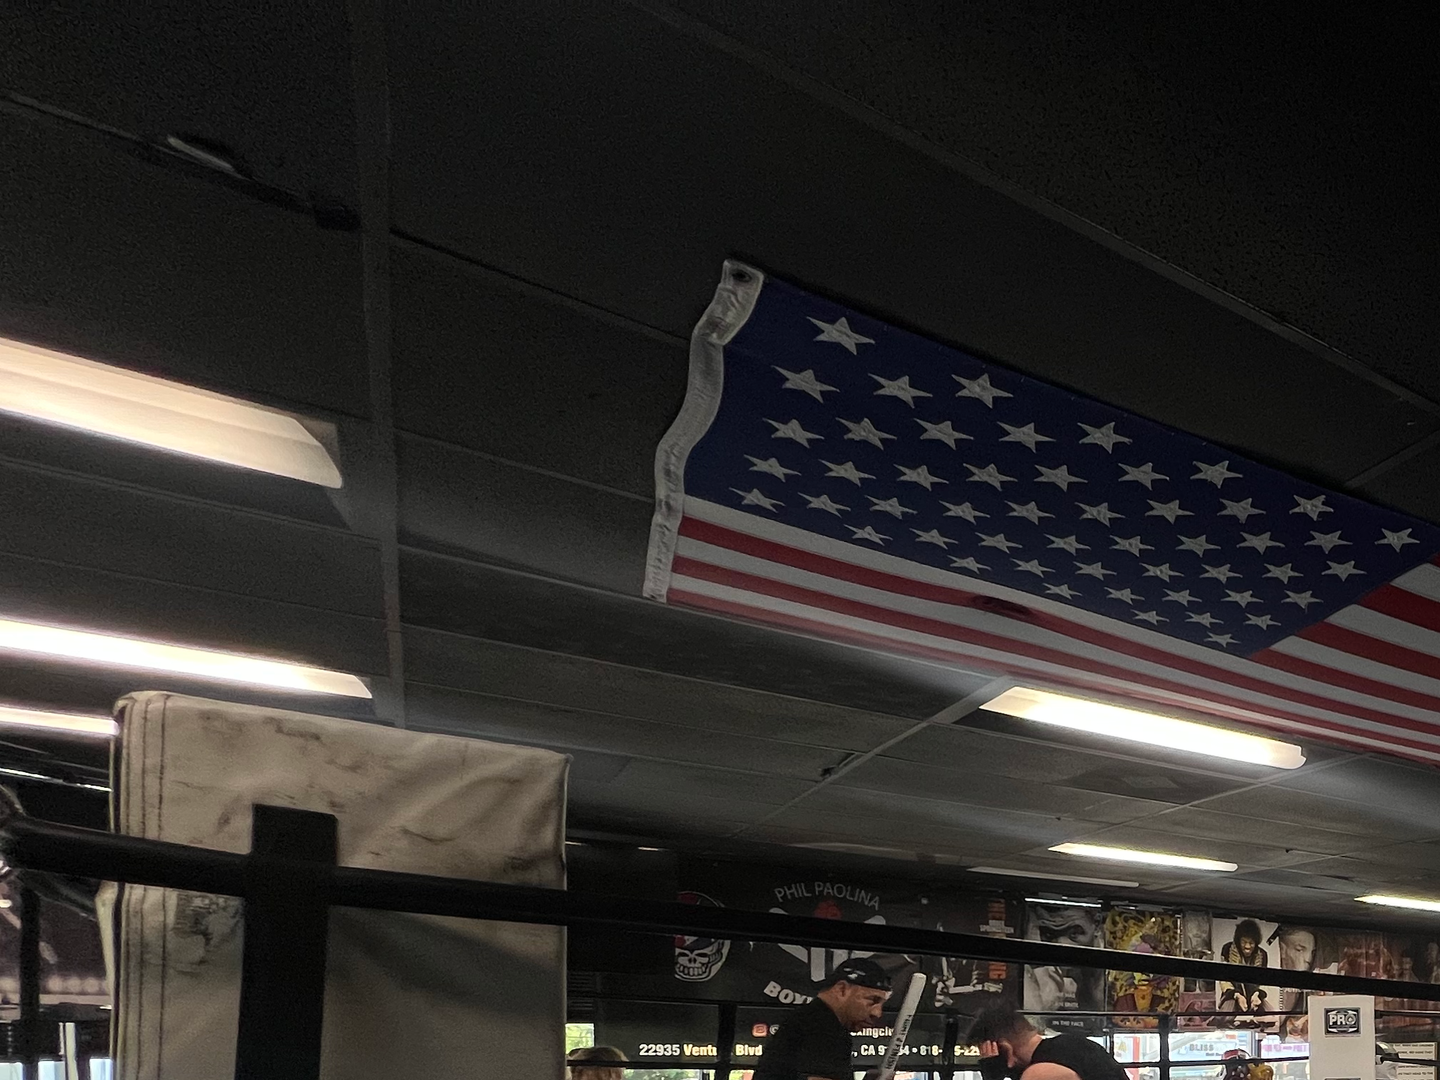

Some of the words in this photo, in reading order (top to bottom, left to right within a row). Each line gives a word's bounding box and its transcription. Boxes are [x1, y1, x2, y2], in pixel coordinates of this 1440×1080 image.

[773, 882, 812, 903] PHIL
[814, 881, 881, 911] PAOLINA
[1329, 1014, 1357, 1026] PRO
[639, 1043, 681, 1057] 22935
[860, 1044, 876, 1056] CA
